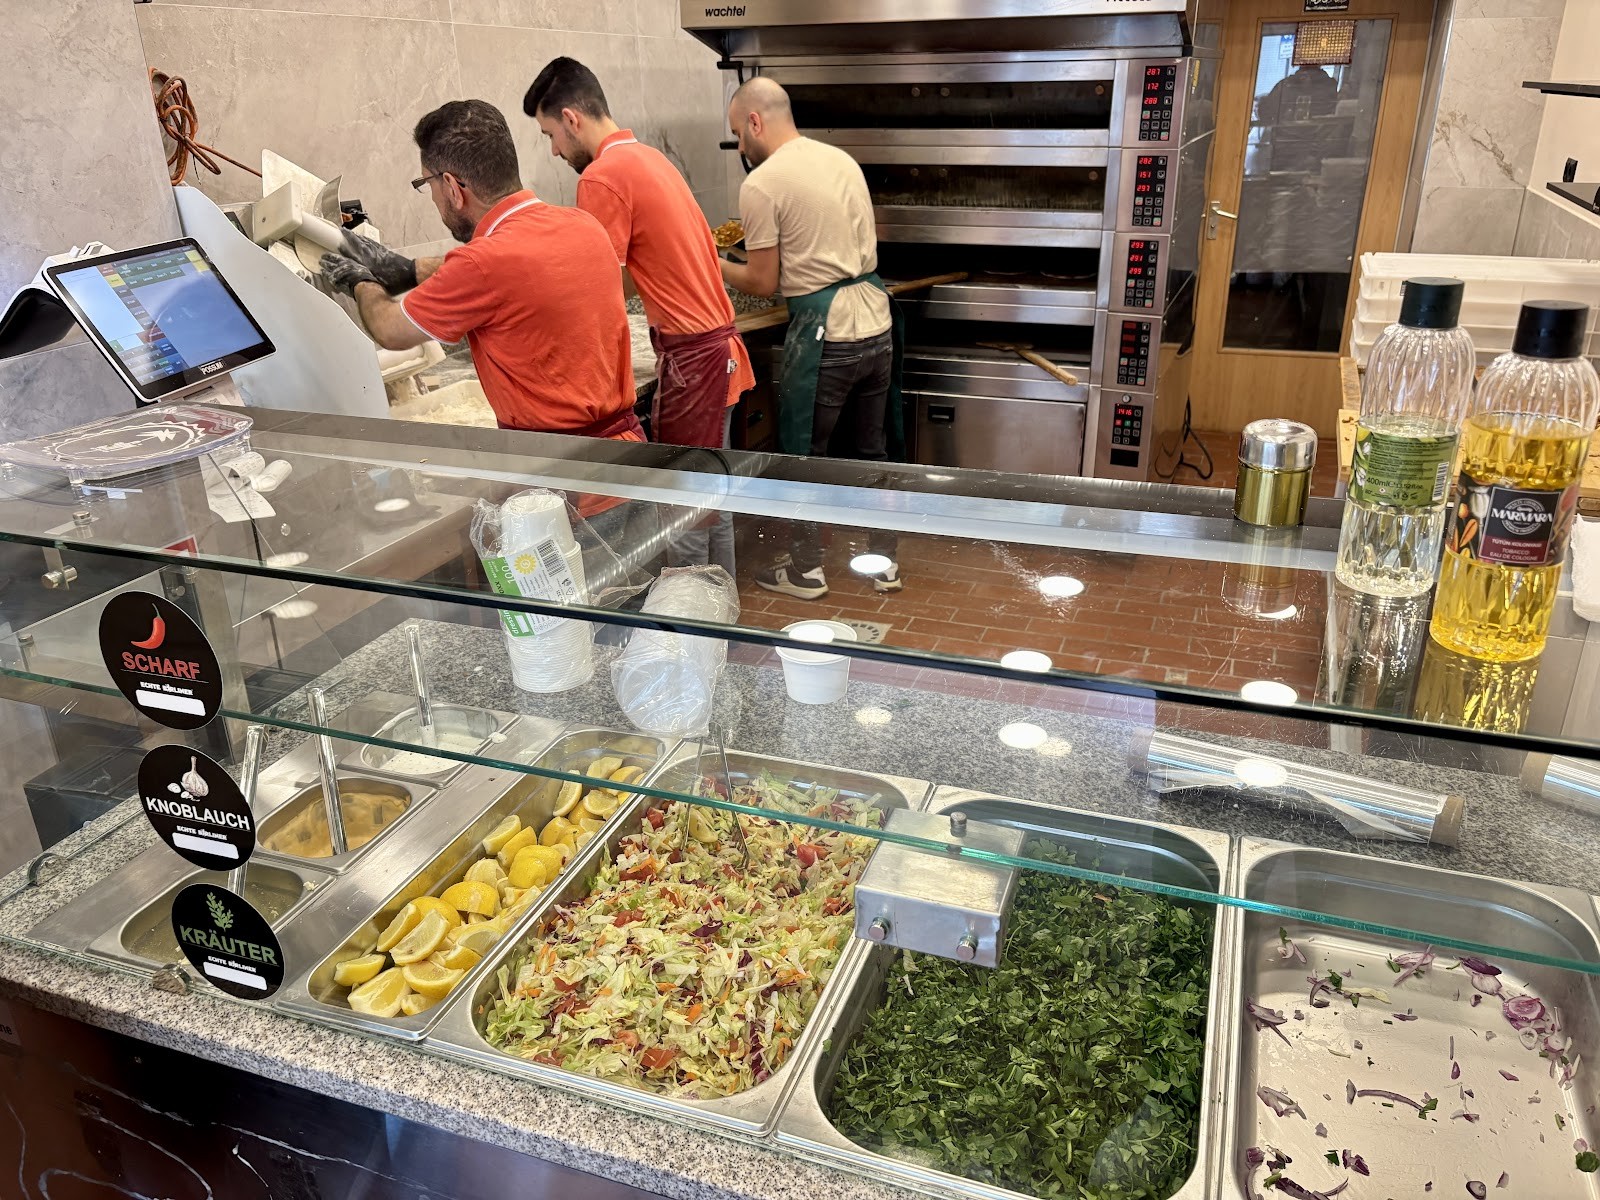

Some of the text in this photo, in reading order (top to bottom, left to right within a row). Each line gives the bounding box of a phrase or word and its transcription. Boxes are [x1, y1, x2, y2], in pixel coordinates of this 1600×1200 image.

[704, 5, 746, 17] wachtel
[1146, 68, 1160, 76] 287
[1147, 82, 1159, 90] 172
[1130, 241, 1144, 249] 293
[1130, 254, 1143, 262] 291
[1128, 267, 1142, 275] 299
[201, 360, 225, 375] POSSUM
[1491, 507, 1553, 523] MARMARA
[1502, 547, 1530, 555] TOBACCO
[121, 651, 201, 680] SCHARF
[145, 796, 251, 831] KNOBLAUCH
[179, 924, 278, 965] KRÄUTER
